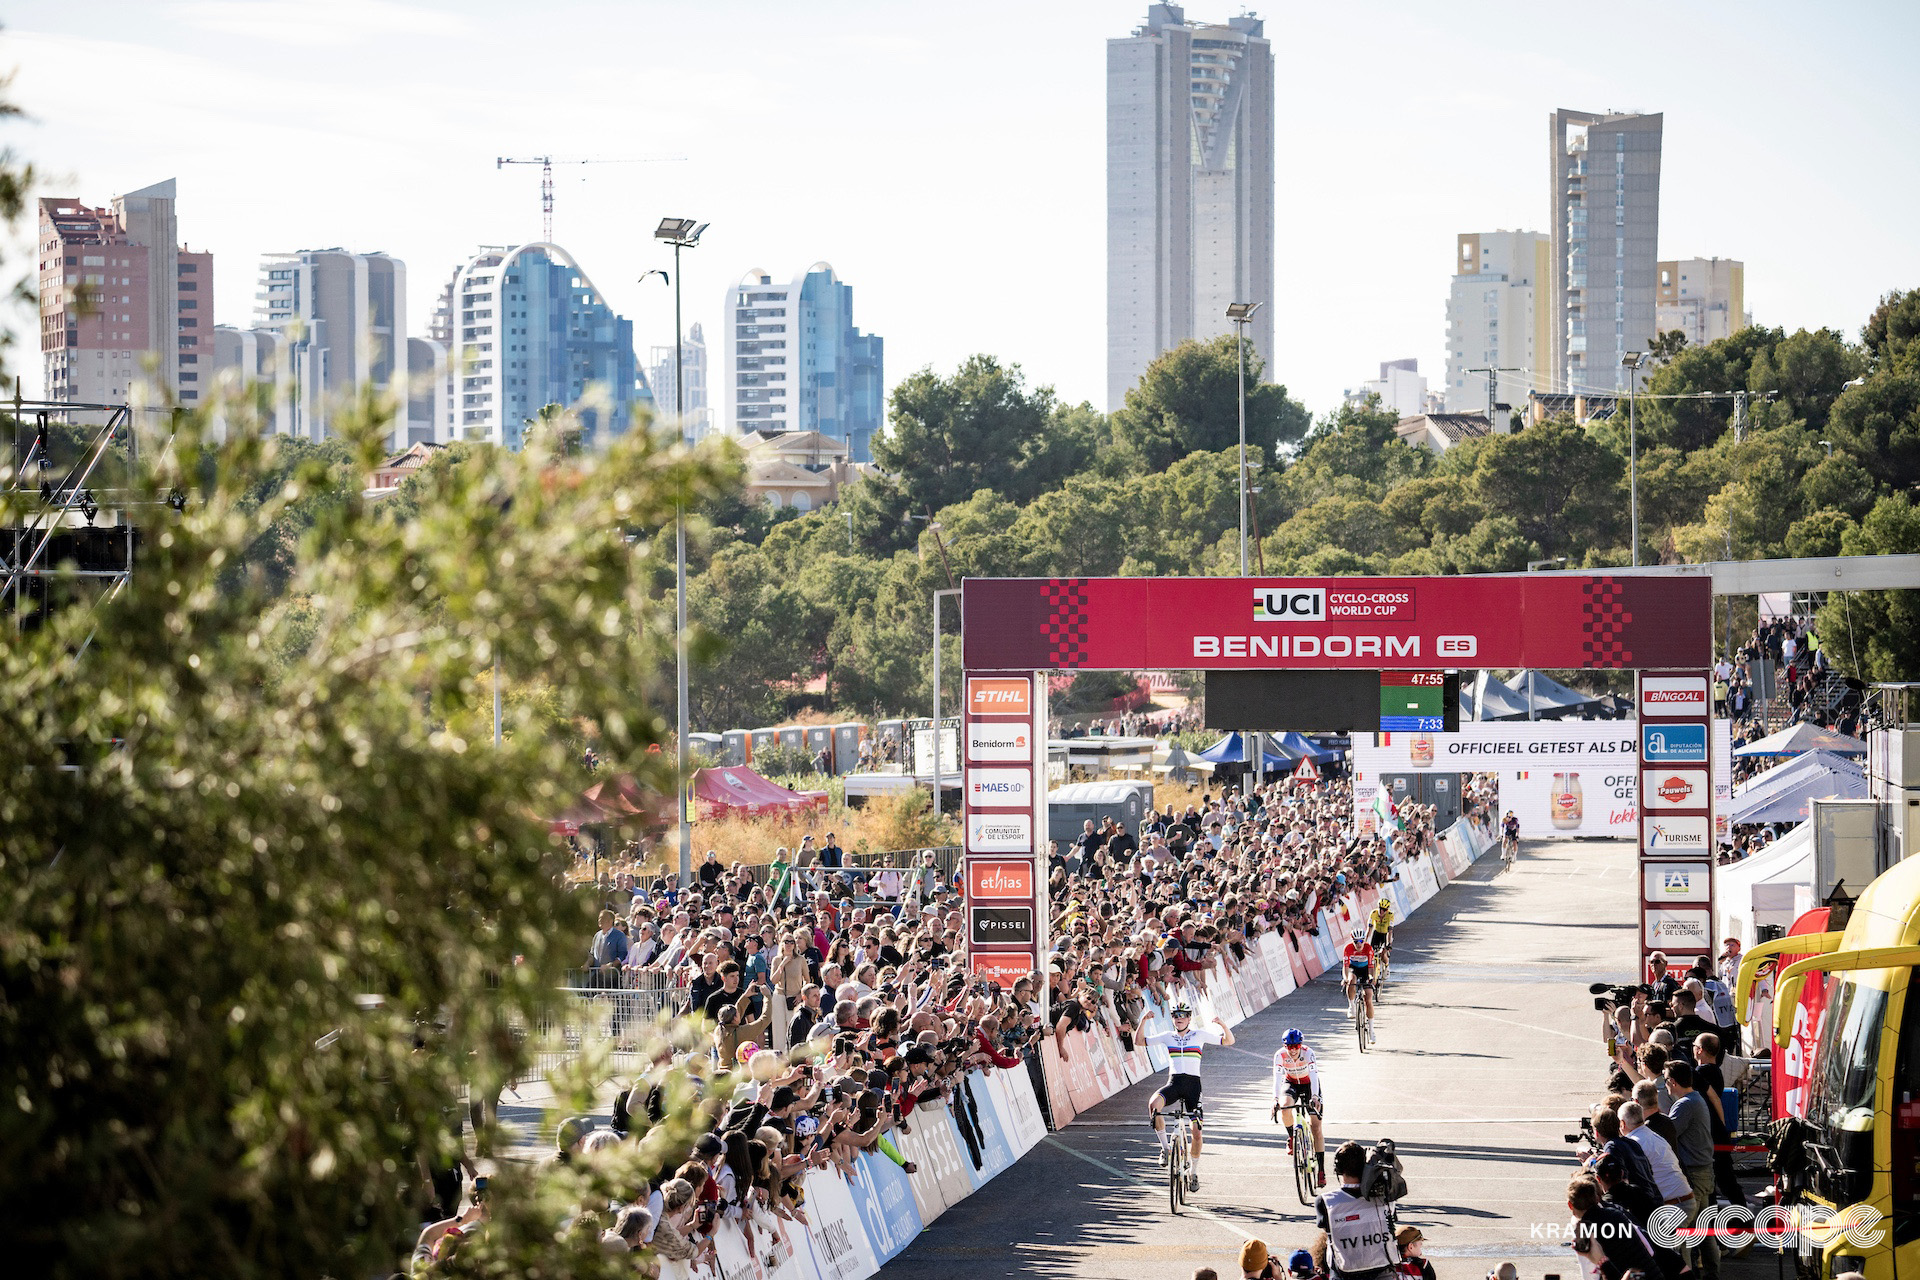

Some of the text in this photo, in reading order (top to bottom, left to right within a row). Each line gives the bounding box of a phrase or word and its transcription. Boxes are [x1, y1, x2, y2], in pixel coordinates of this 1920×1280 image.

[1266, 594, 1319, 615] UCI
[1330, 594, 1409, 604] CYCLO-CROSS
[1331, 606, 1397, 616] WORLD CUP
[1193, 636, 1471, 658] BENIDORM ES
[1411, 673, 1444, 685] 47:55
[974, 691, 1024, 702] STIHL
[1418, 719, 1443, 731] 7:33
[973, 739, 1014, 748] Benidorm
[1449, 743, 1523, 754] OFFICIEEL
[1529, 742, 1584, 753] GETEST
[1588, 741, 1616, 753] ALS
[982, 783, 1009, 792] MAES
[1660, 786, 1691, 794] Pauwels
[1664, 834, 1702, 842] TURISME
[980, 866, 1022, 893] ethias
[990, 921, 1025, 929] PISSEI
[913, 1119, 964, 1190] PISSEI
[814, 1218, 853, 1266] TURISME
[1340, 1237, 1358, 1249] TV
